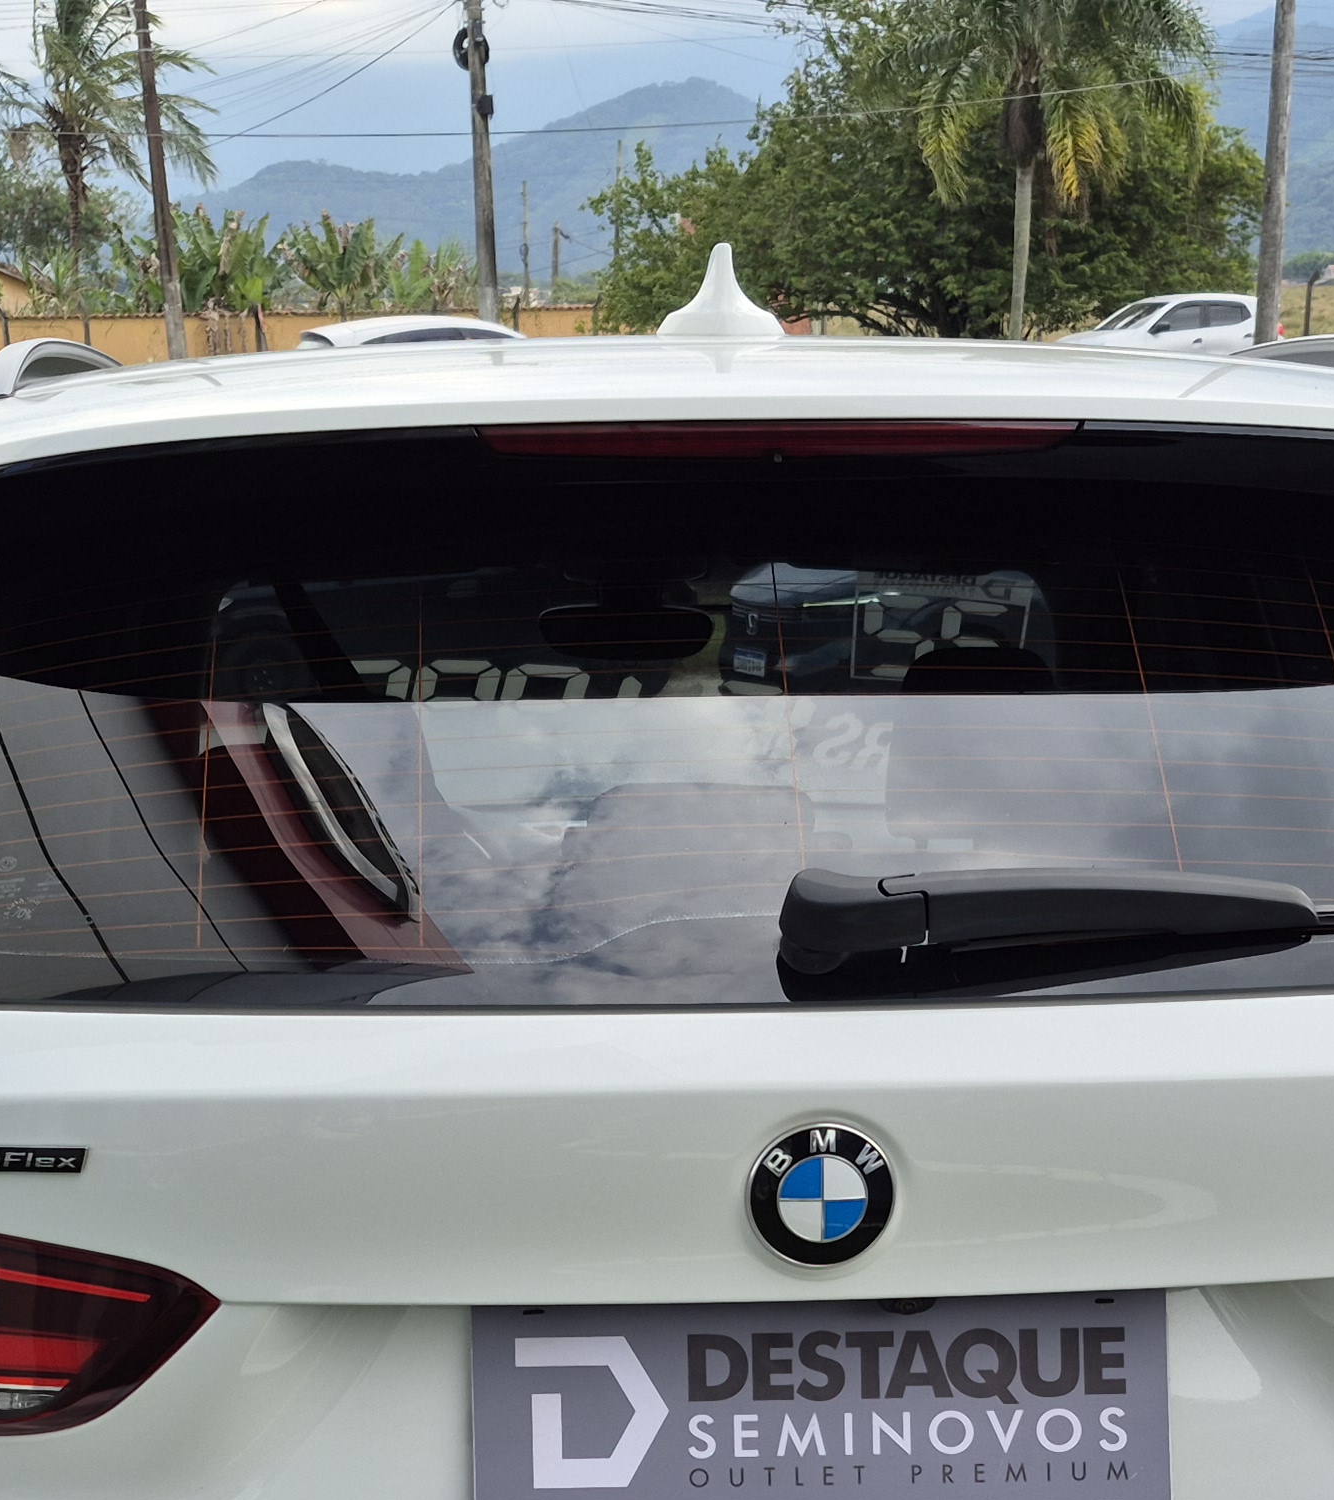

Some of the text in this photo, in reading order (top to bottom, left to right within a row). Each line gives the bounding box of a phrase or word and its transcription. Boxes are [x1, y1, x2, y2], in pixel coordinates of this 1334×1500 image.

[762, 1128, 885, 1178] BMW
[687, 1326, 1127, 1405] DESTAQUE
[687, 1406, 1128, 1460] SEMINOVOS
[688, 1460, 1131, 1489] OUTLET PREMIUM
